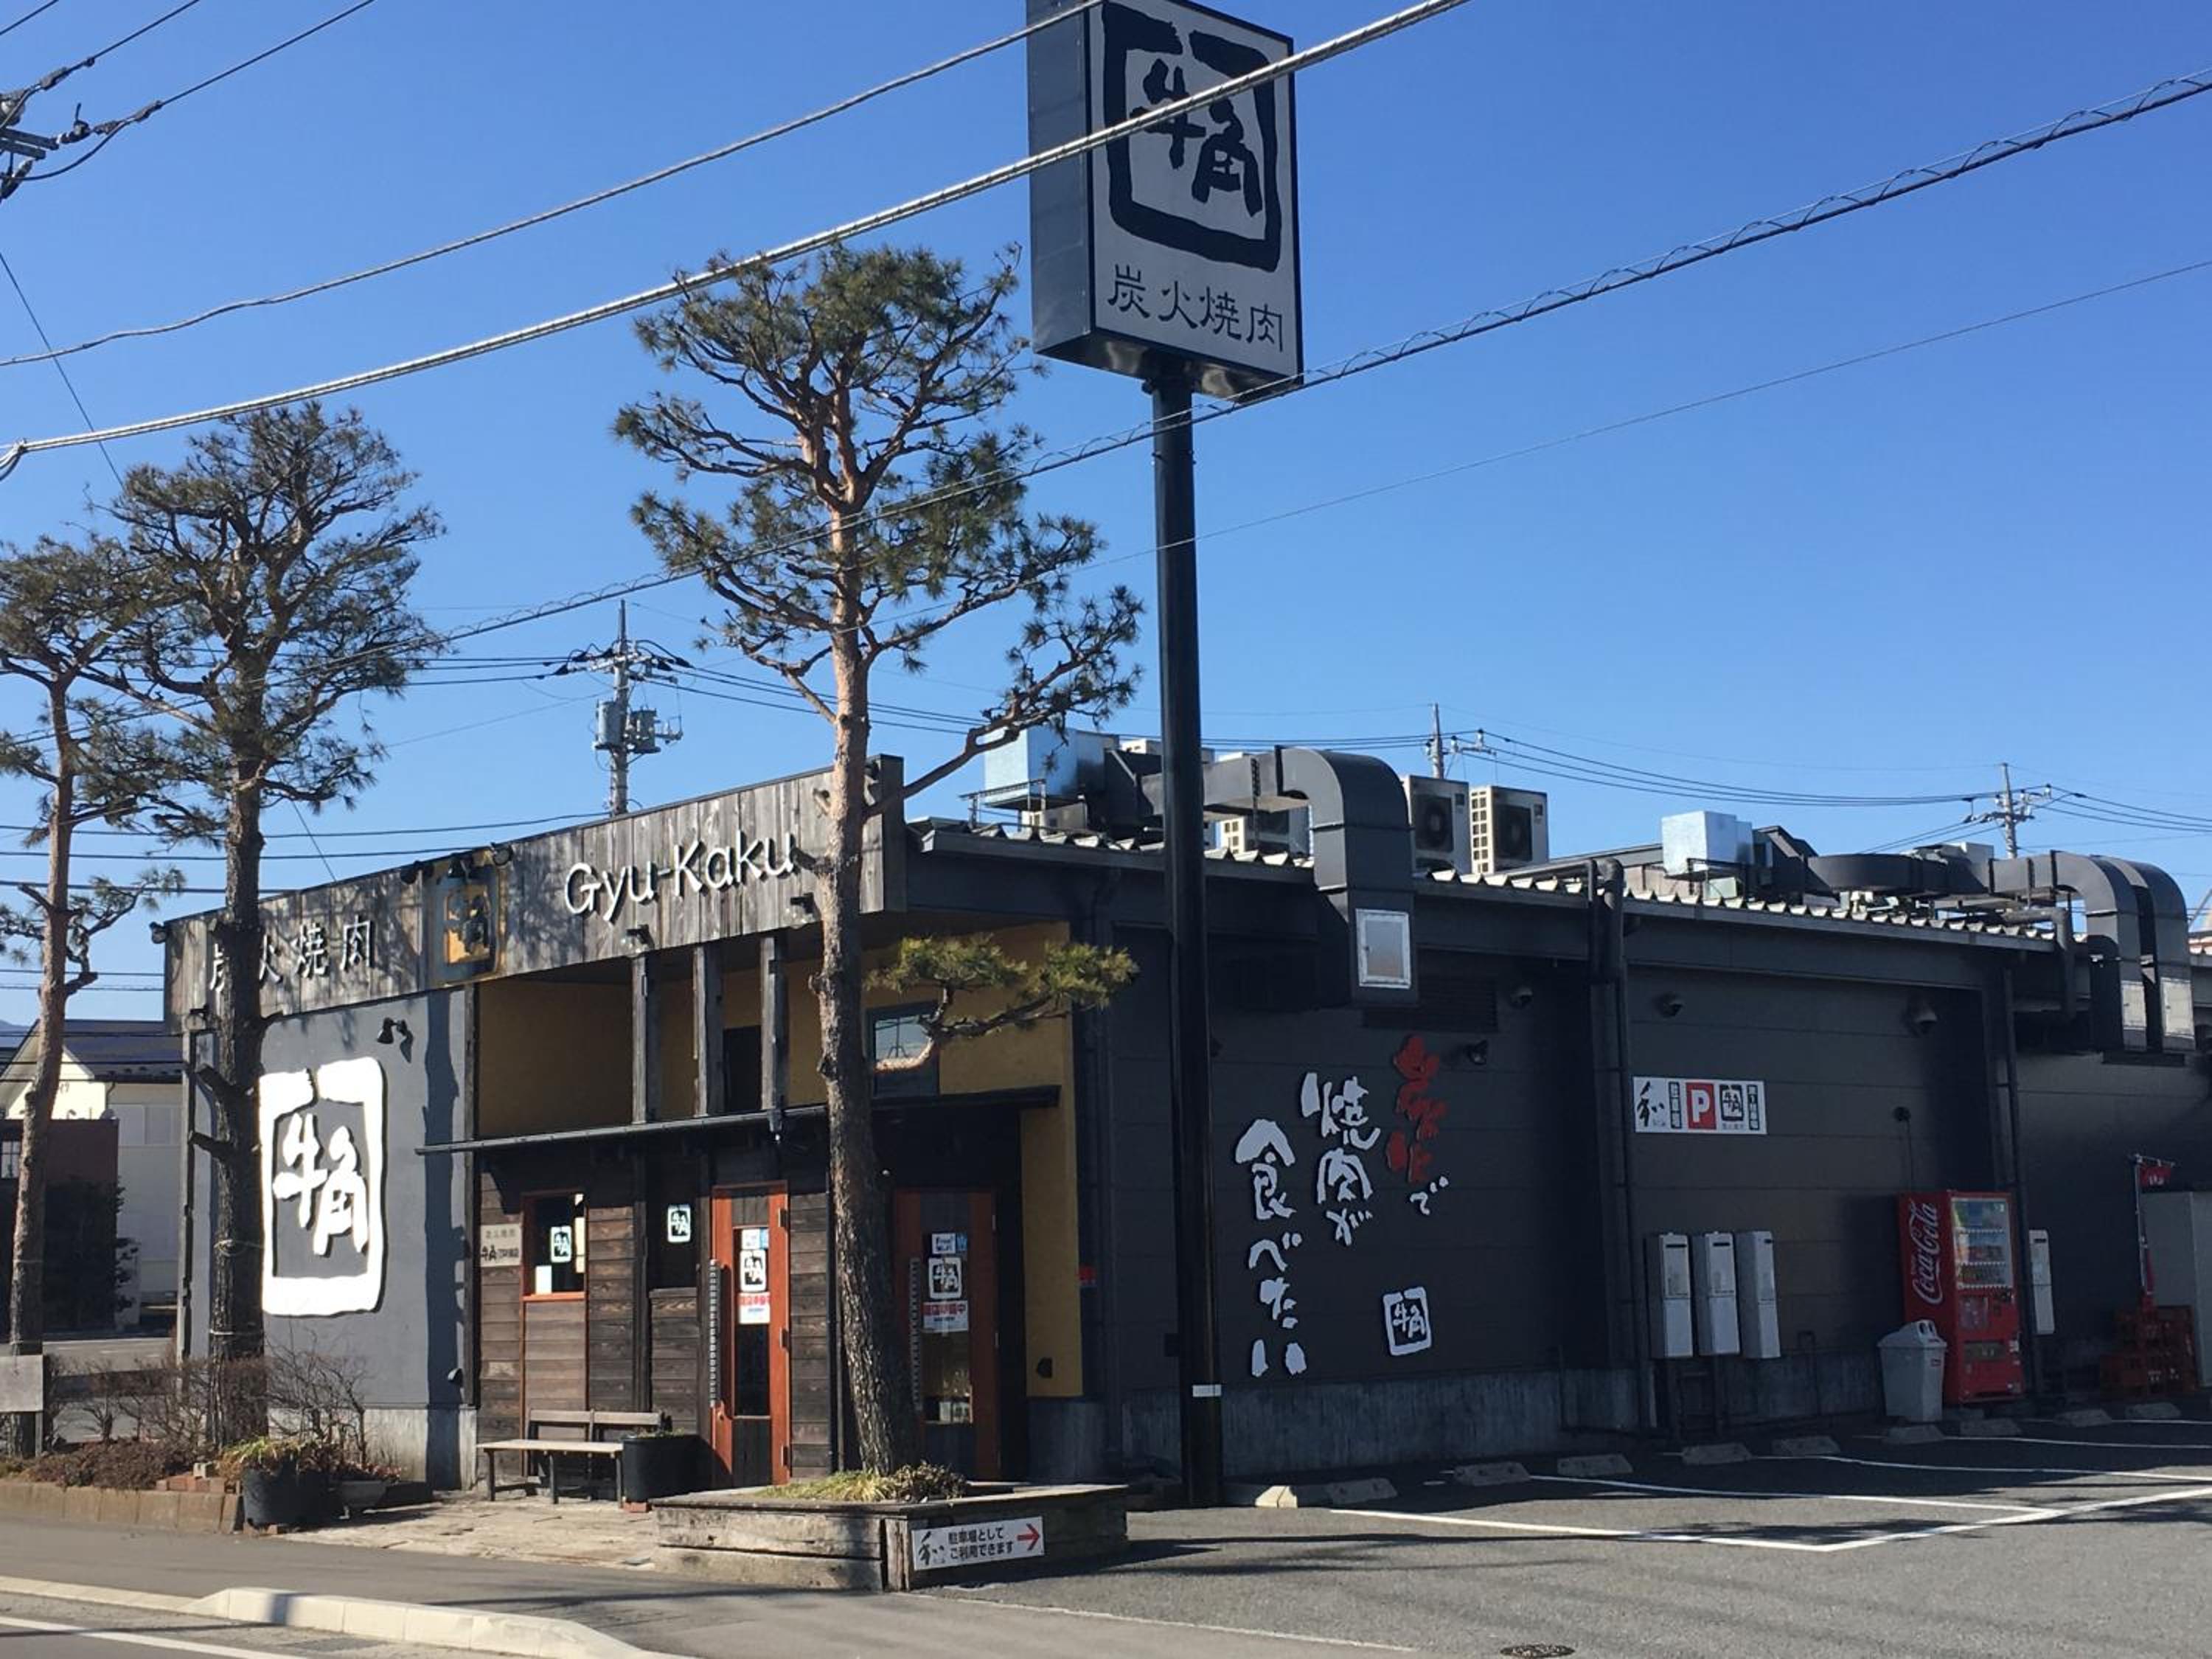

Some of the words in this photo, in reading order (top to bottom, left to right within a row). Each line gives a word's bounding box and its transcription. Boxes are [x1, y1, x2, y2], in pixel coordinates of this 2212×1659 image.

[1130, 58, 1262, 217] 牛角
[1107, 264, 1284, 352] 炭火焼肉
[564, 830, 795, 922] Gyu-Kaku
[1691, 1089, 1710, 1123] P
[272, 1111, 368, 1255] 牛角
[1301, 1072, 1381, 1246] 焼肉が
[1235, 1118, 1307, 1377] 食べたい
[1393, 1304, 1426, 1338] 牛角
[950, 1541, 1014, 1559] ご利用できます
